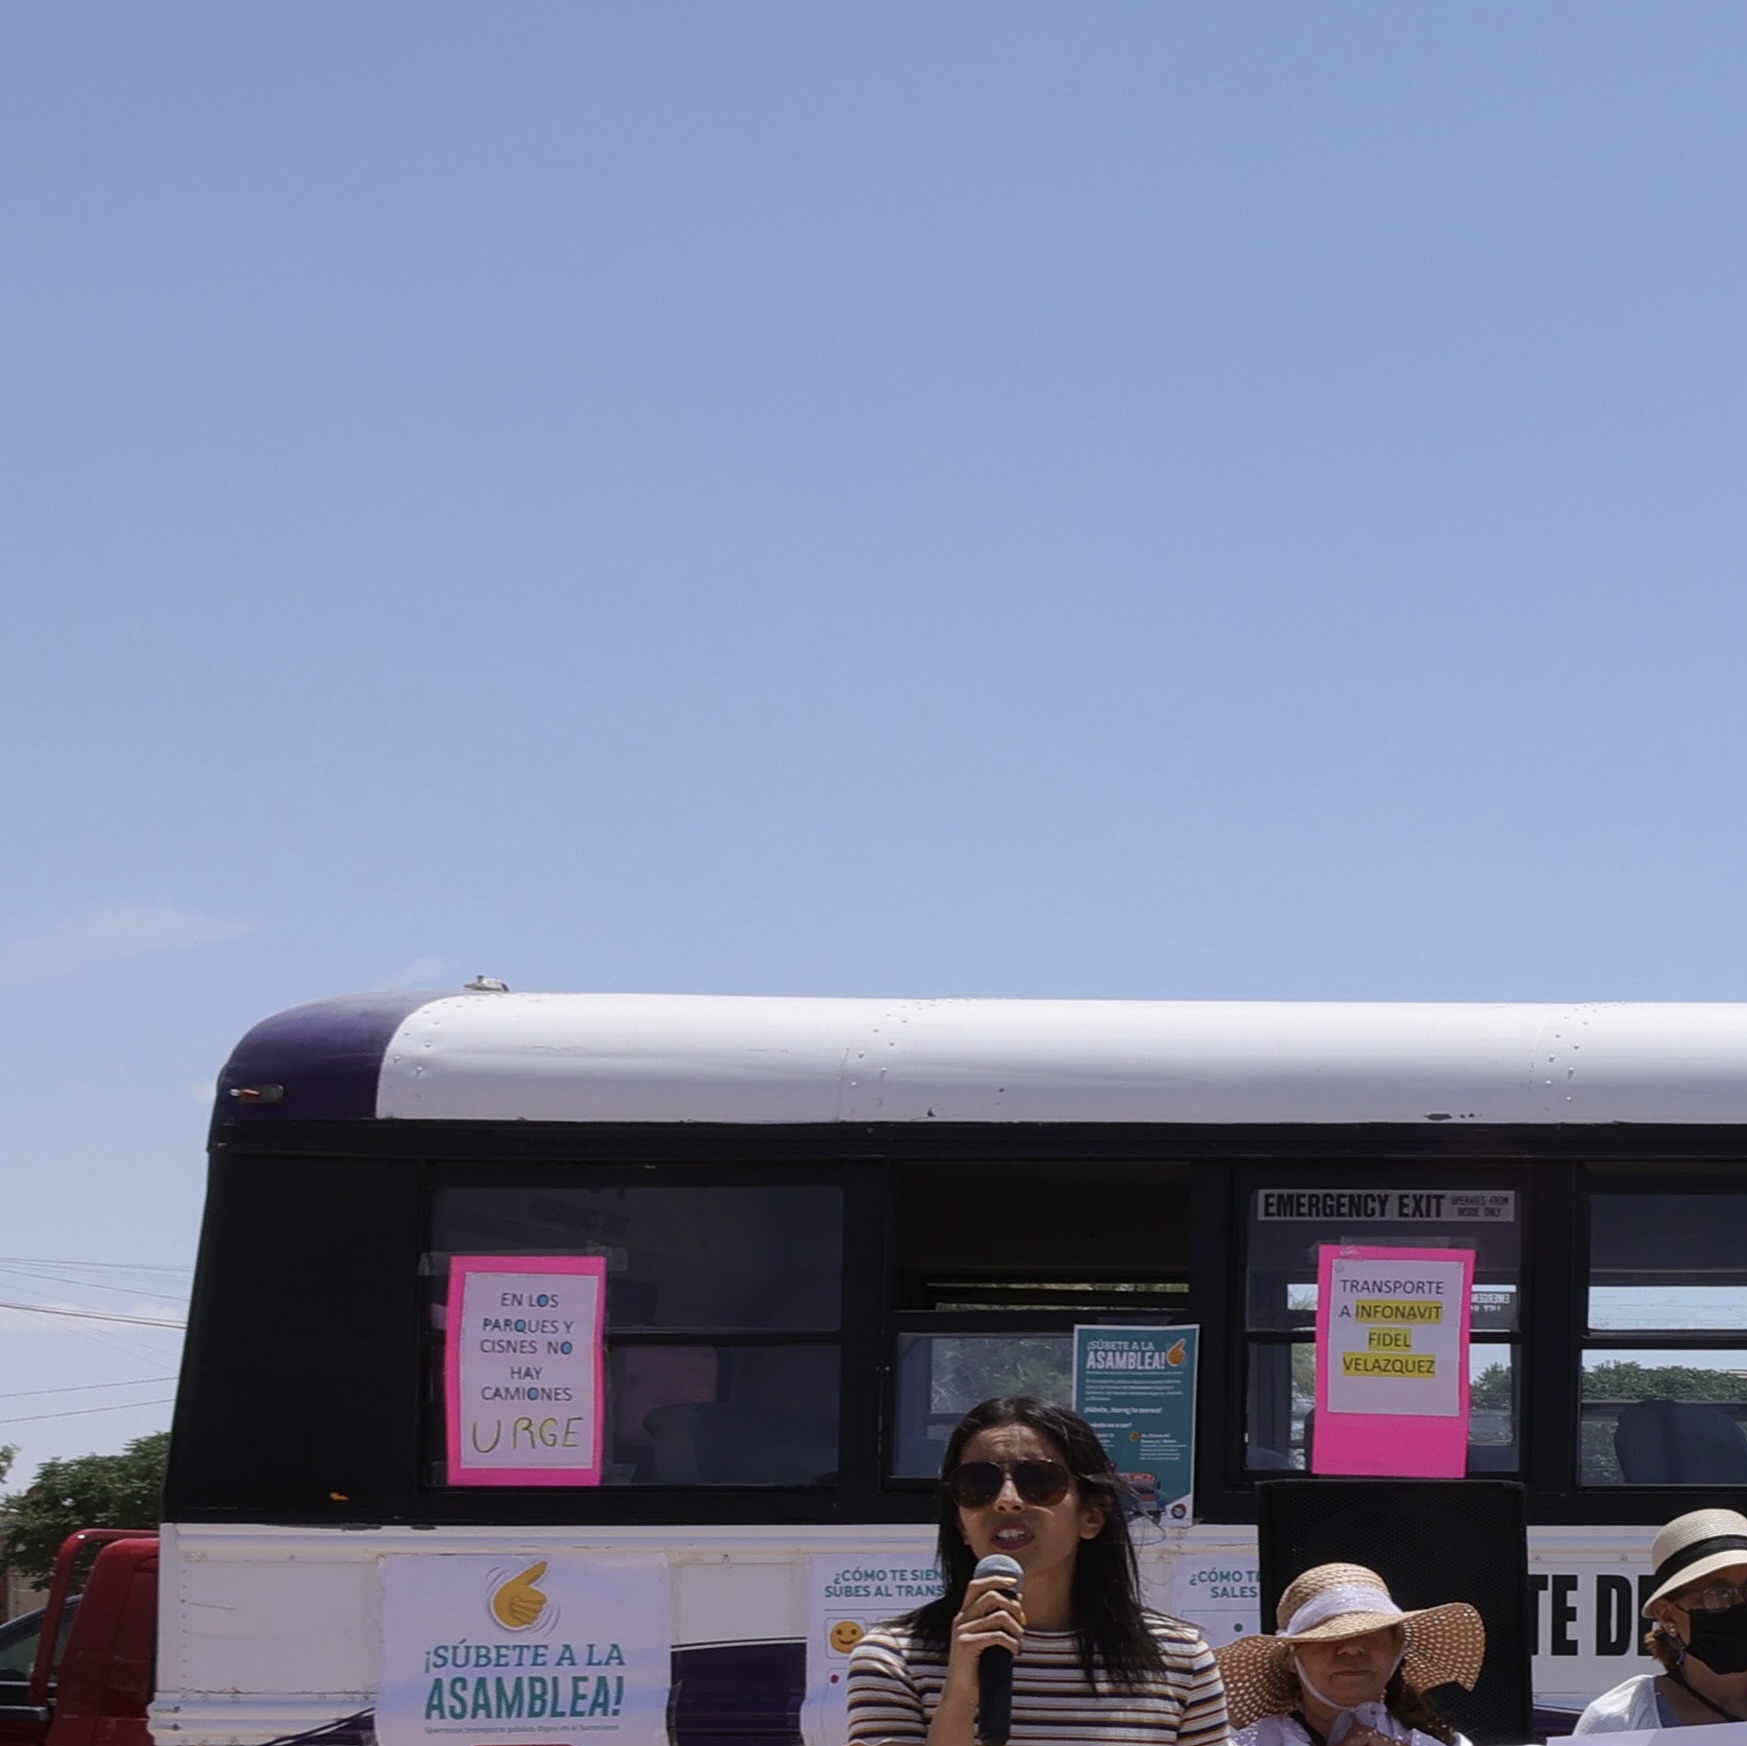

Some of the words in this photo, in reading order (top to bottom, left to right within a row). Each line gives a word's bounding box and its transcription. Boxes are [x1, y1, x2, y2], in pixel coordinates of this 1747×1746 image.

[1264, 1194, 1390, 1217] EMERGENCY
[1400, 1194, 1446, 1218] EXIT
[1340, 1279, 1445, 1295] TRANSPORTE
[501, 1292, 523, 1306] EN
[529, 1293, 559, 1308] LOS
[1340, 1305, 1350, 1318] A
[1356, 1304, 1442, 1320] INFONAVIT
[482, 1318, 559, 1334] PARQUES
[564, 1320, 574, 1333] Y
[480, 1339, 538, 1354] CISNES
[547, 1340, 574, 1355] NO
[1368, 1331, 1411, 1348] FIDEL
[1086, 1351, 1166, 1370] ASAMBLEA!
[1343, 1356, 1435, 1374] VELAZQUEZ
[510, 1366, 543, 1380] HAY
[481, 1386, 573, 1401] CAMIONES
[472, 1416, 583, 1453] URGE
[833, 1566, 887, 1585] ¿CÓMO
[890, 1569, 908, 1581] TE
[911, 1569, 944, 1581] SIEN
[1190, 1567, 1243, 1586] ¿CÓMO
[824, 1585, 871, 1597] SUBES
[874, 1585, 893, 1597] AL
[895, 1584, 945, 1597] TRANS
[1211, 1586, 1258, 1598] SALES
[425, 1639, 548, 1673] ¡SÚBETE
[556, 1644, 578, 1667] A
[586, 1644, 626, 1666] LA
[425, 1676, 625, 1720] ASAMBLEA!
